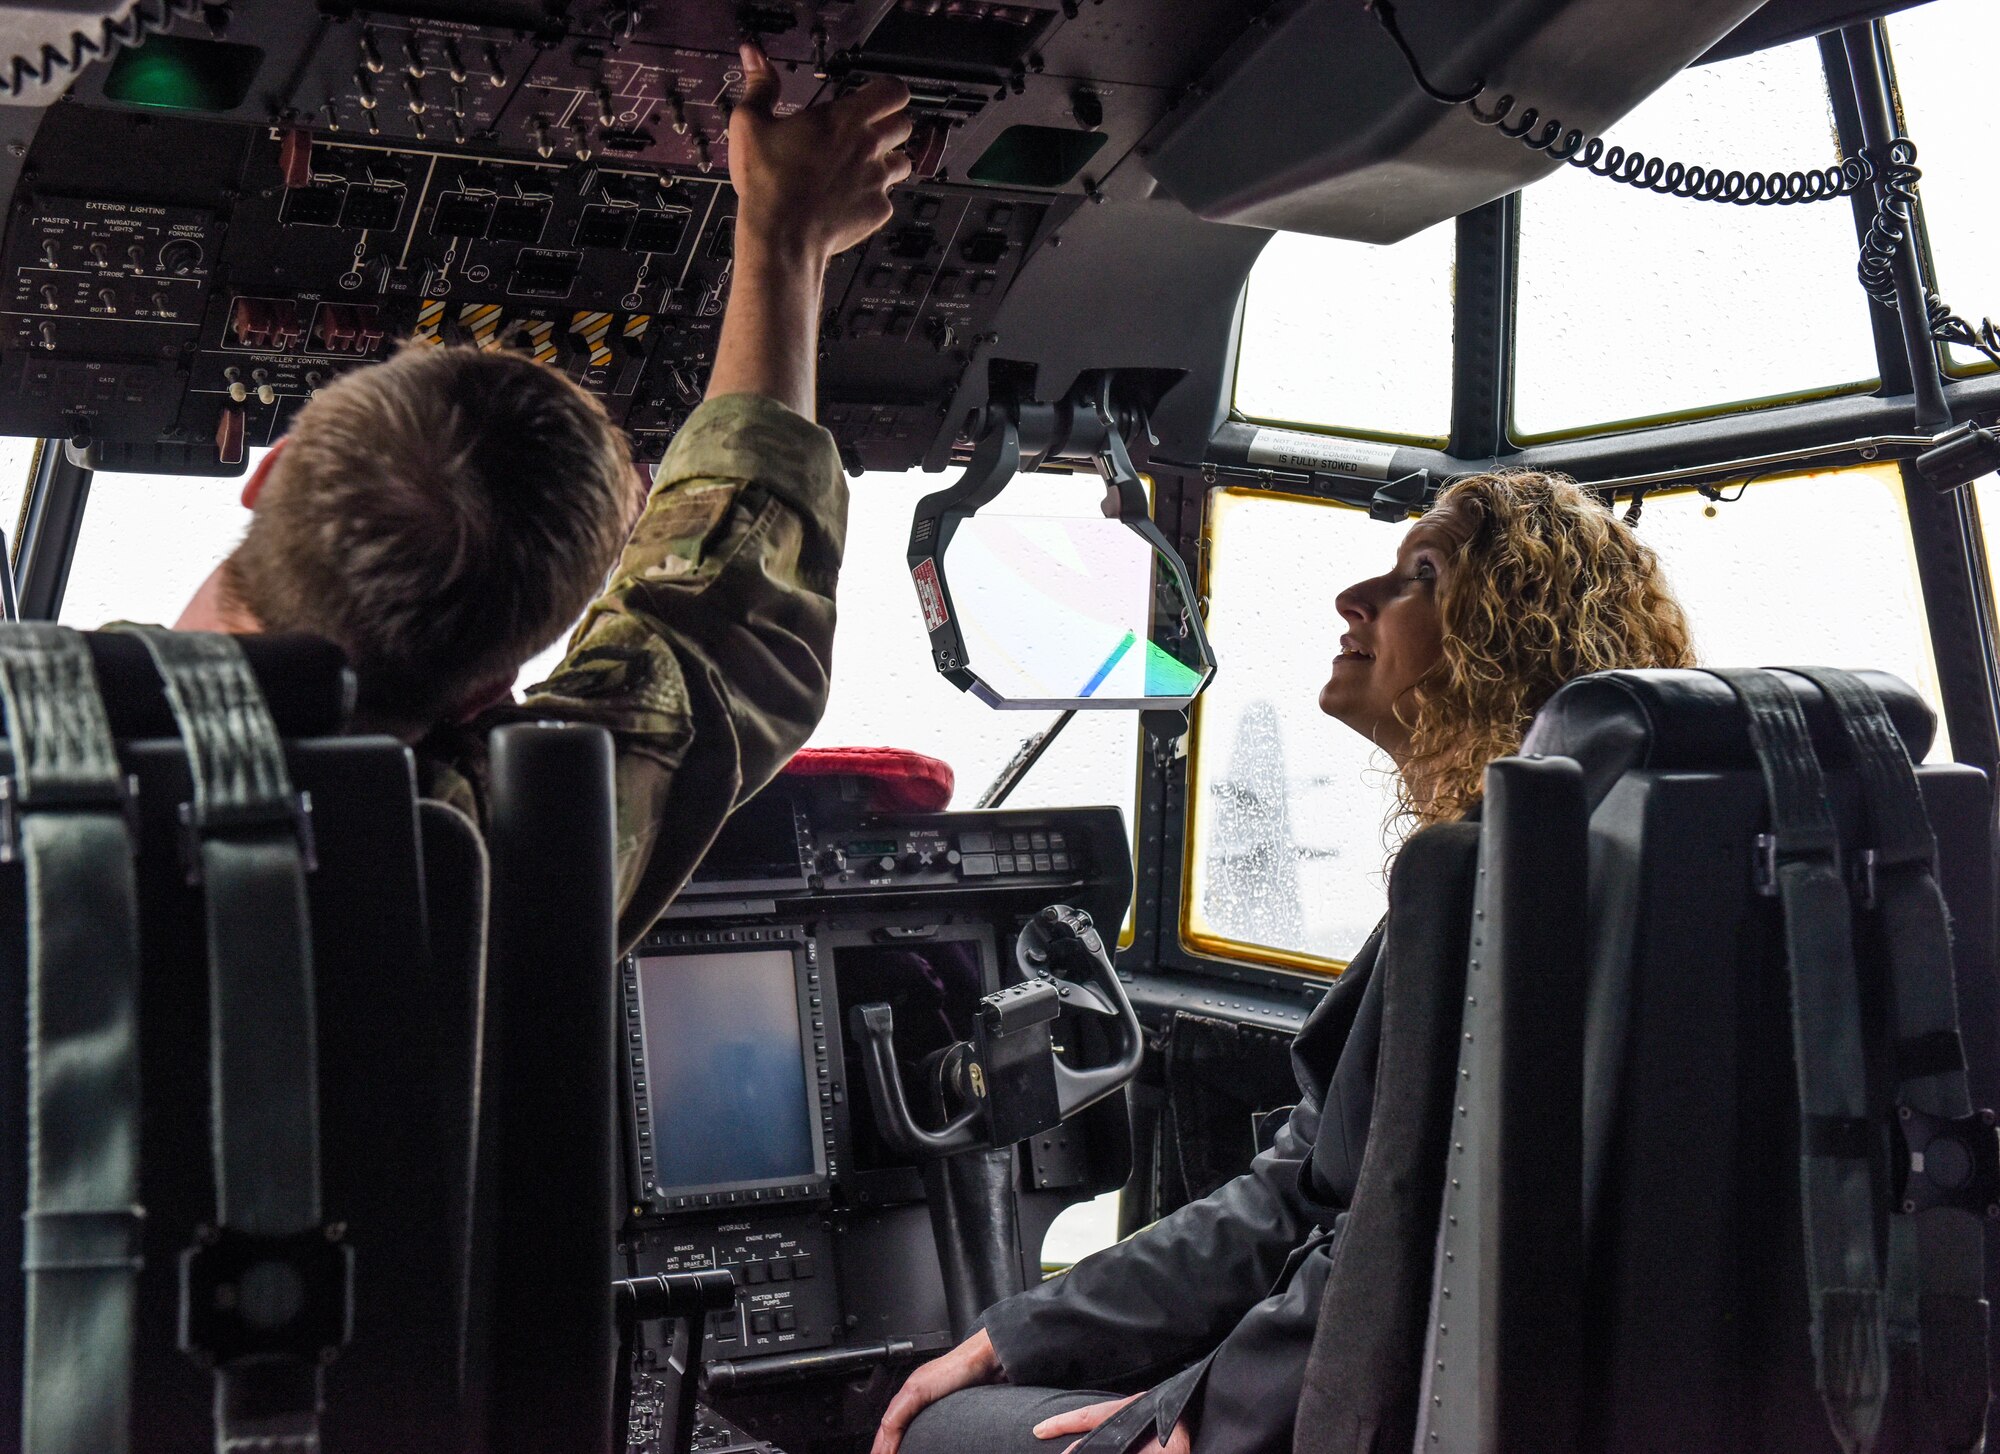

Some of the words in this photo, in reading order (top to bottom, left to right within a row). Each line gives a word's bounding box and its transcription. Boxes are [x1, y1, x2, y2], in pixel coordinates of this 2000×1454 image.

[86, 202, 126, 212] EXTERIOR
[130, 207, 166, 215] LIGHTING
[104, 219, 142, 227] NAVIGATION
[1272, 445, 1296, 453] UNTIL
[1323, 451, 1369, 462] COMBINER
[1294, 440, 1350, 452] OPEN/CLOSE
[1356, 449, 1391, 457] WINDOW
[1279, 455, 1287, 463] IS
[1291, 456, 1318, 467] FULLY
[1321, 460, 1357, 472] STOWED
[718, 1223, 750, 1232] HYDRAULIC
